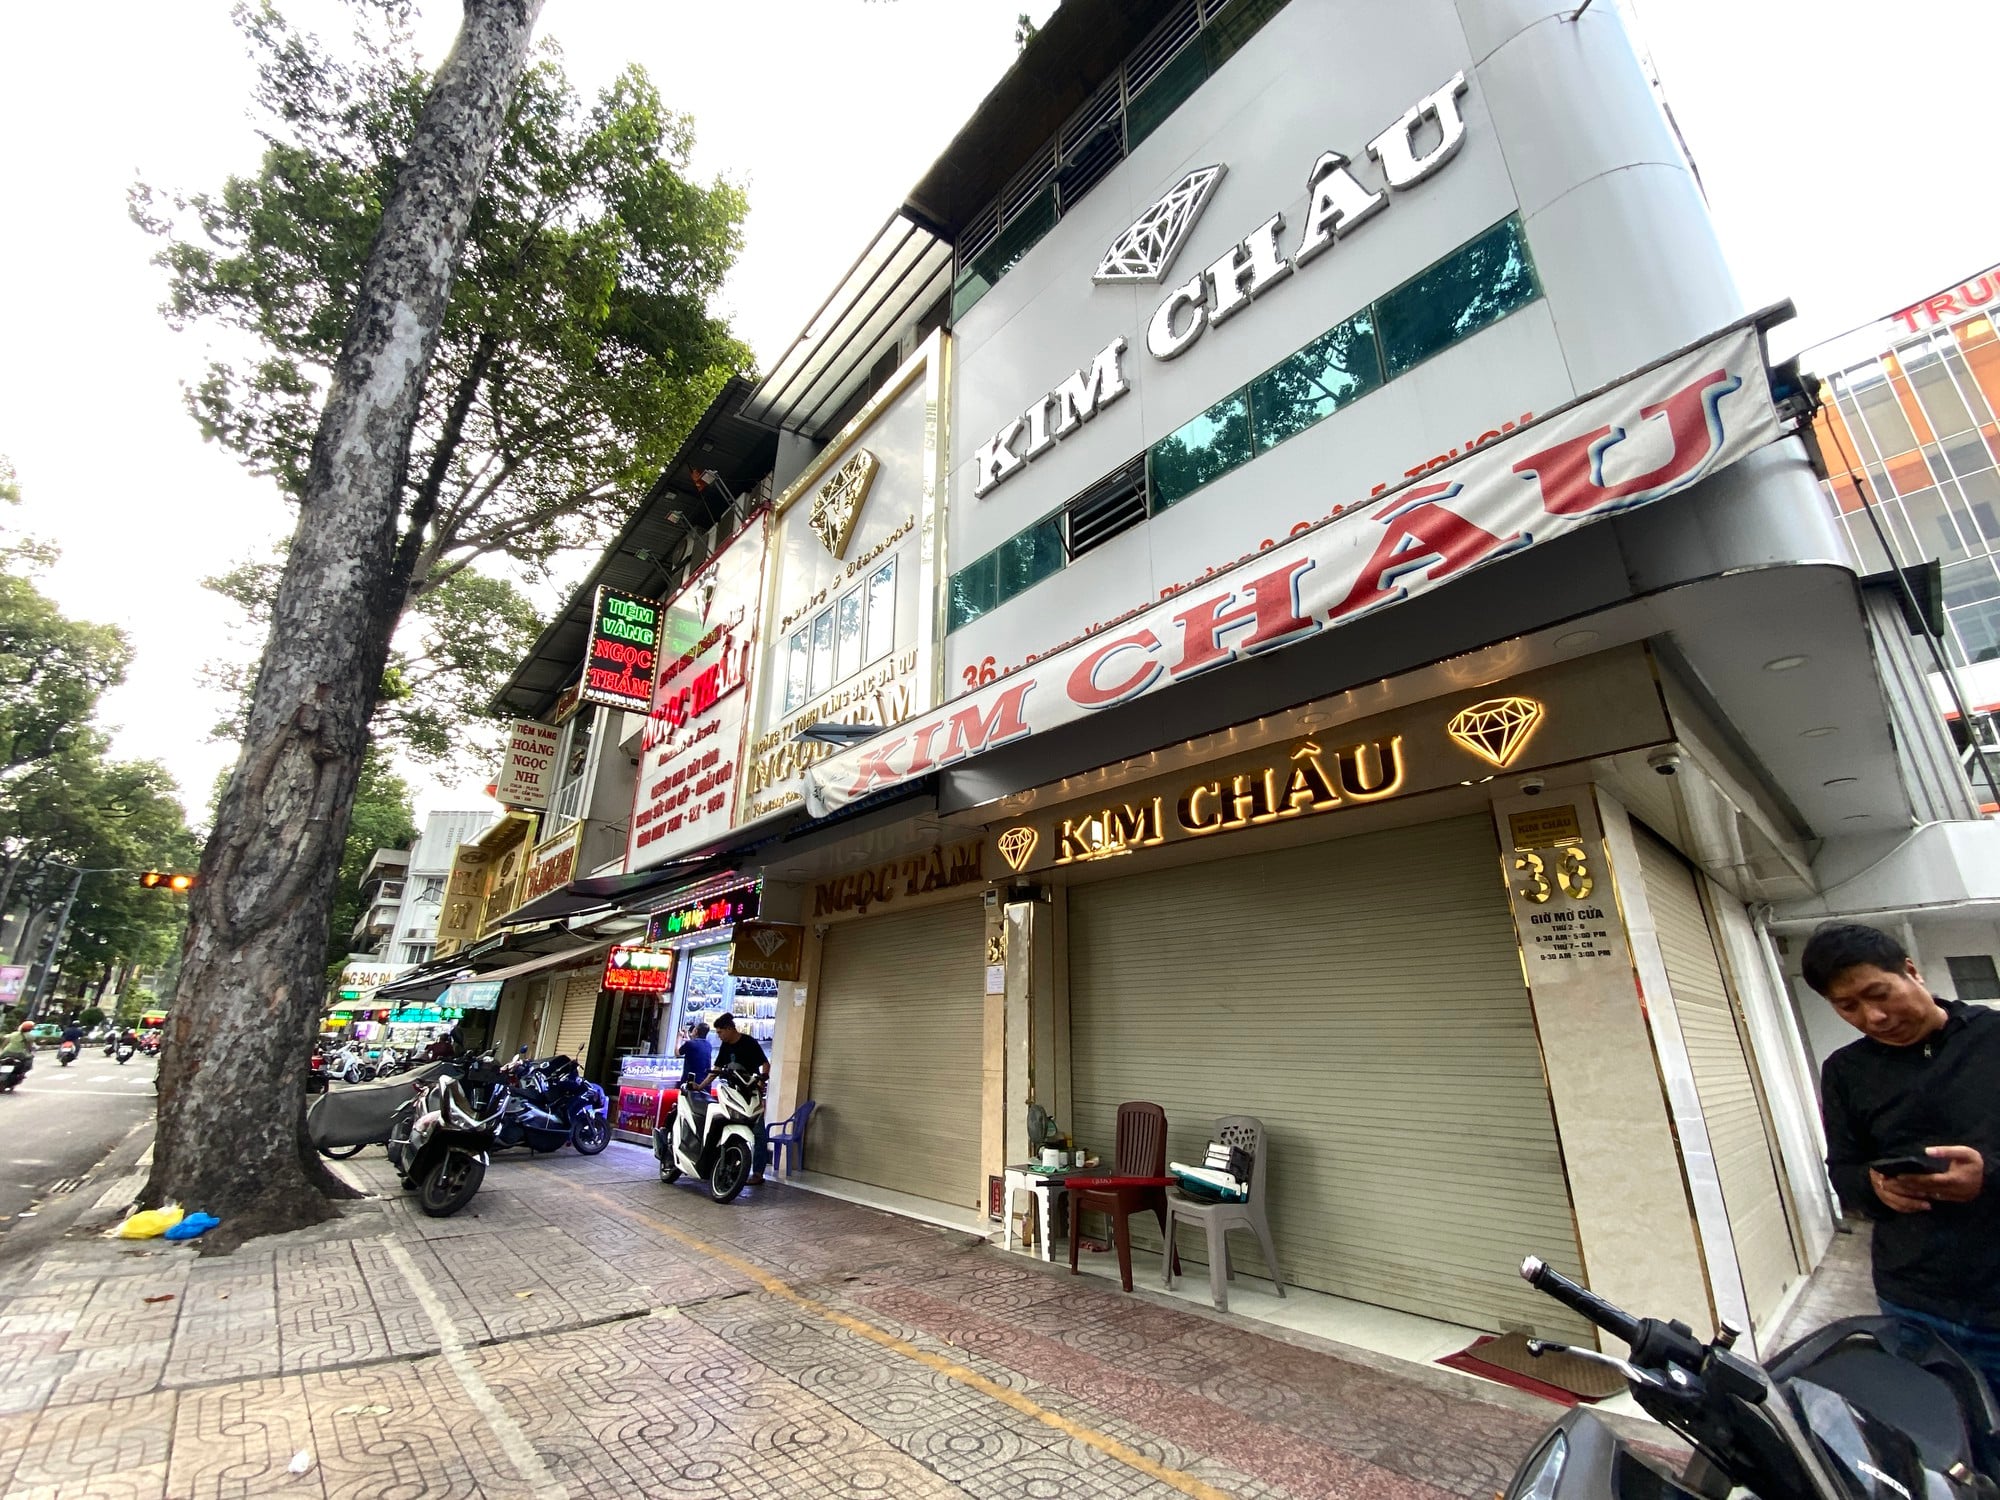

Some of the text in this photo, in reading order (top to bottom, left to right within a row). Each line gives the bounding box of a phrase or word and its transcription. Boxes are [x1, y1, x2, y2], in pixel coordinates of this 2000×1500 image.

[974, 70, 1469, 499] KIM CHÂU
[848, 366, 1743, 798] KIM CHÂU
[608, 597, 654, 625] TIỆM
[602, 616, 654, 645] VÀNG
[594, 639, 652, 669] NGỌC
[589, 667, 650, 699] THẨM
[516, 723, 558, 741] TIỆM VÀNG
[511, 738, 555, 757] HOÀNG
[512, 753, 548, 771] NGỌC
[514, 770, 540, 785] NHI
[1053, 735, 1403, 865] KIM CHÂU
[812, 842, 985, 915] NGỌC TÂM
[1514, 846, 1594, 904] 36
[1530, 904, 1605, 925] GIỜ MỞ CỬA
